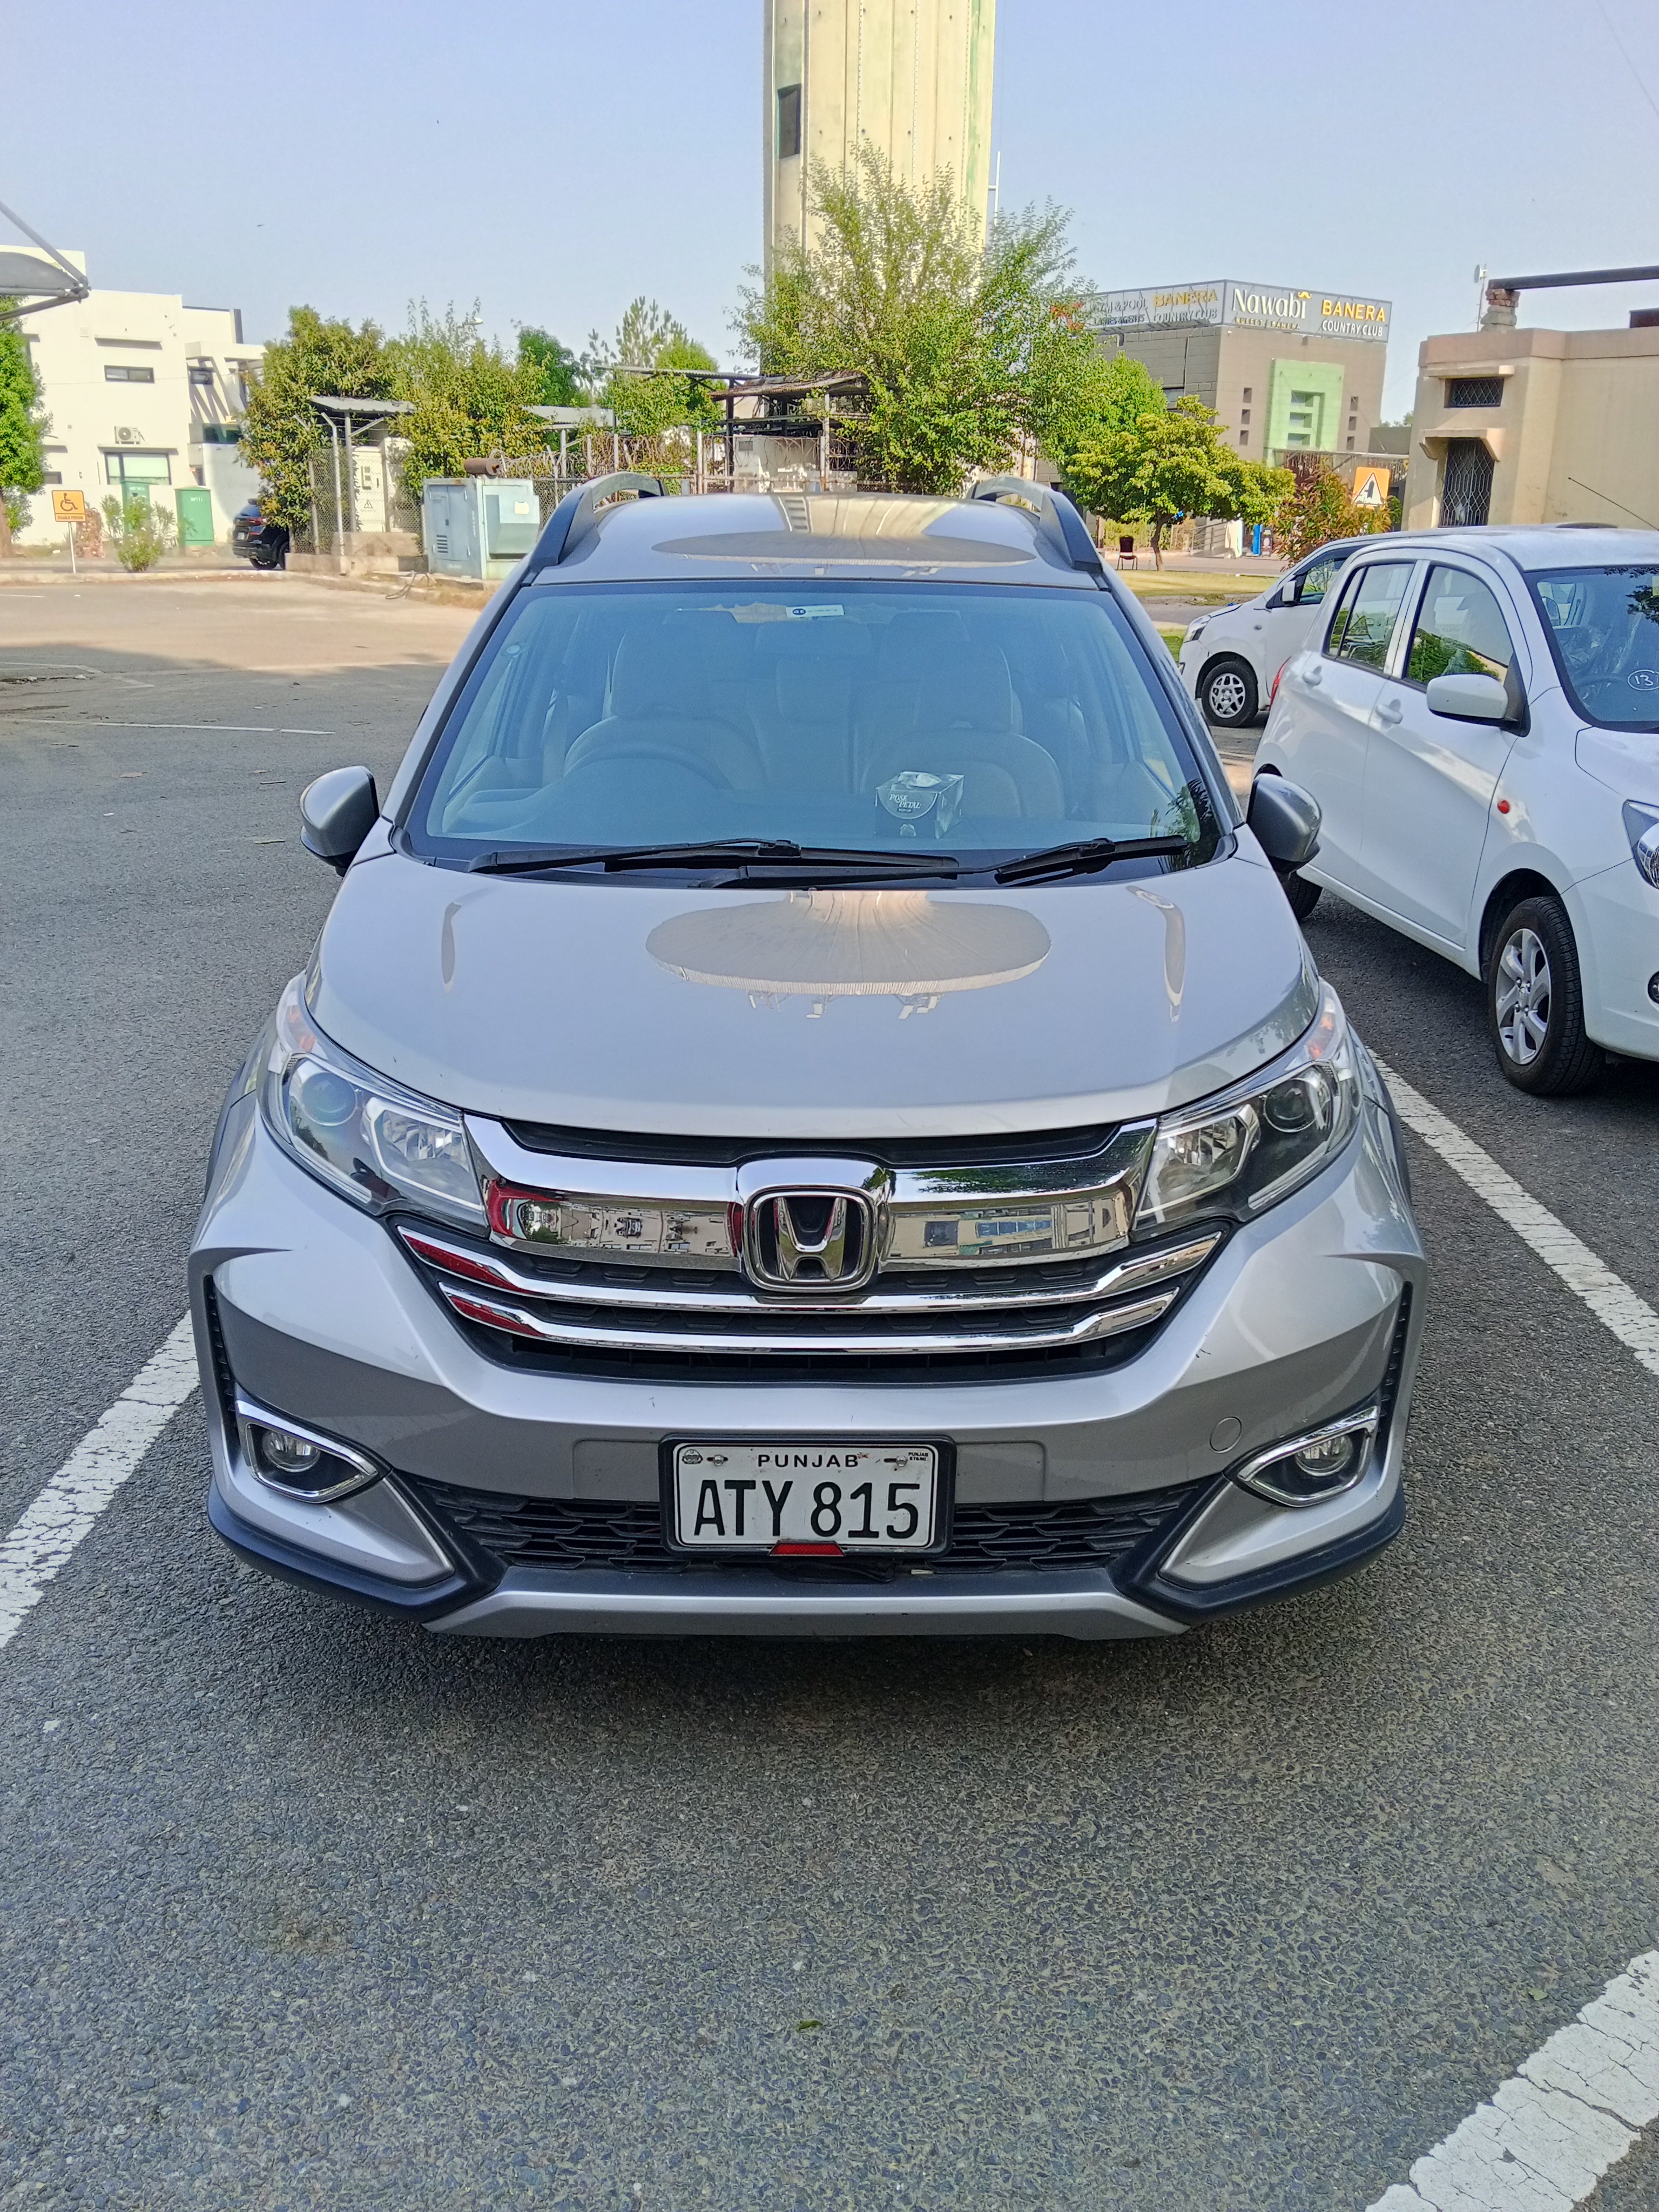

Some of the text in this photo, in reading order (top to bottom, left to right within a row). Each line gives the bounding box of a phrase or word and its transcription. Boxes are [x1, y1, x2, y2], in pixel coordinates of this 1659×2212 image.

[1123, 298, 1146, 311] POOL
[1153, 289, 1218, 307] BANERA
[1232, 288, 1306, 319] Nawabi
[1153, 308, 1218, 323] COUNTRY CLUB
[1321, 299, 1386, 322] BANERA
[1235, 316, 1263, 326] BUFFET
[1323, 320, 1384, 337] COUNTRY CLUB
[1635, 674, 1654, 686] 13
[899, 800, 921, 809] PETAL
[757, 1454, 860, 1468] PUNJAB
[693, 1479, 921, 1539] ATY 815
